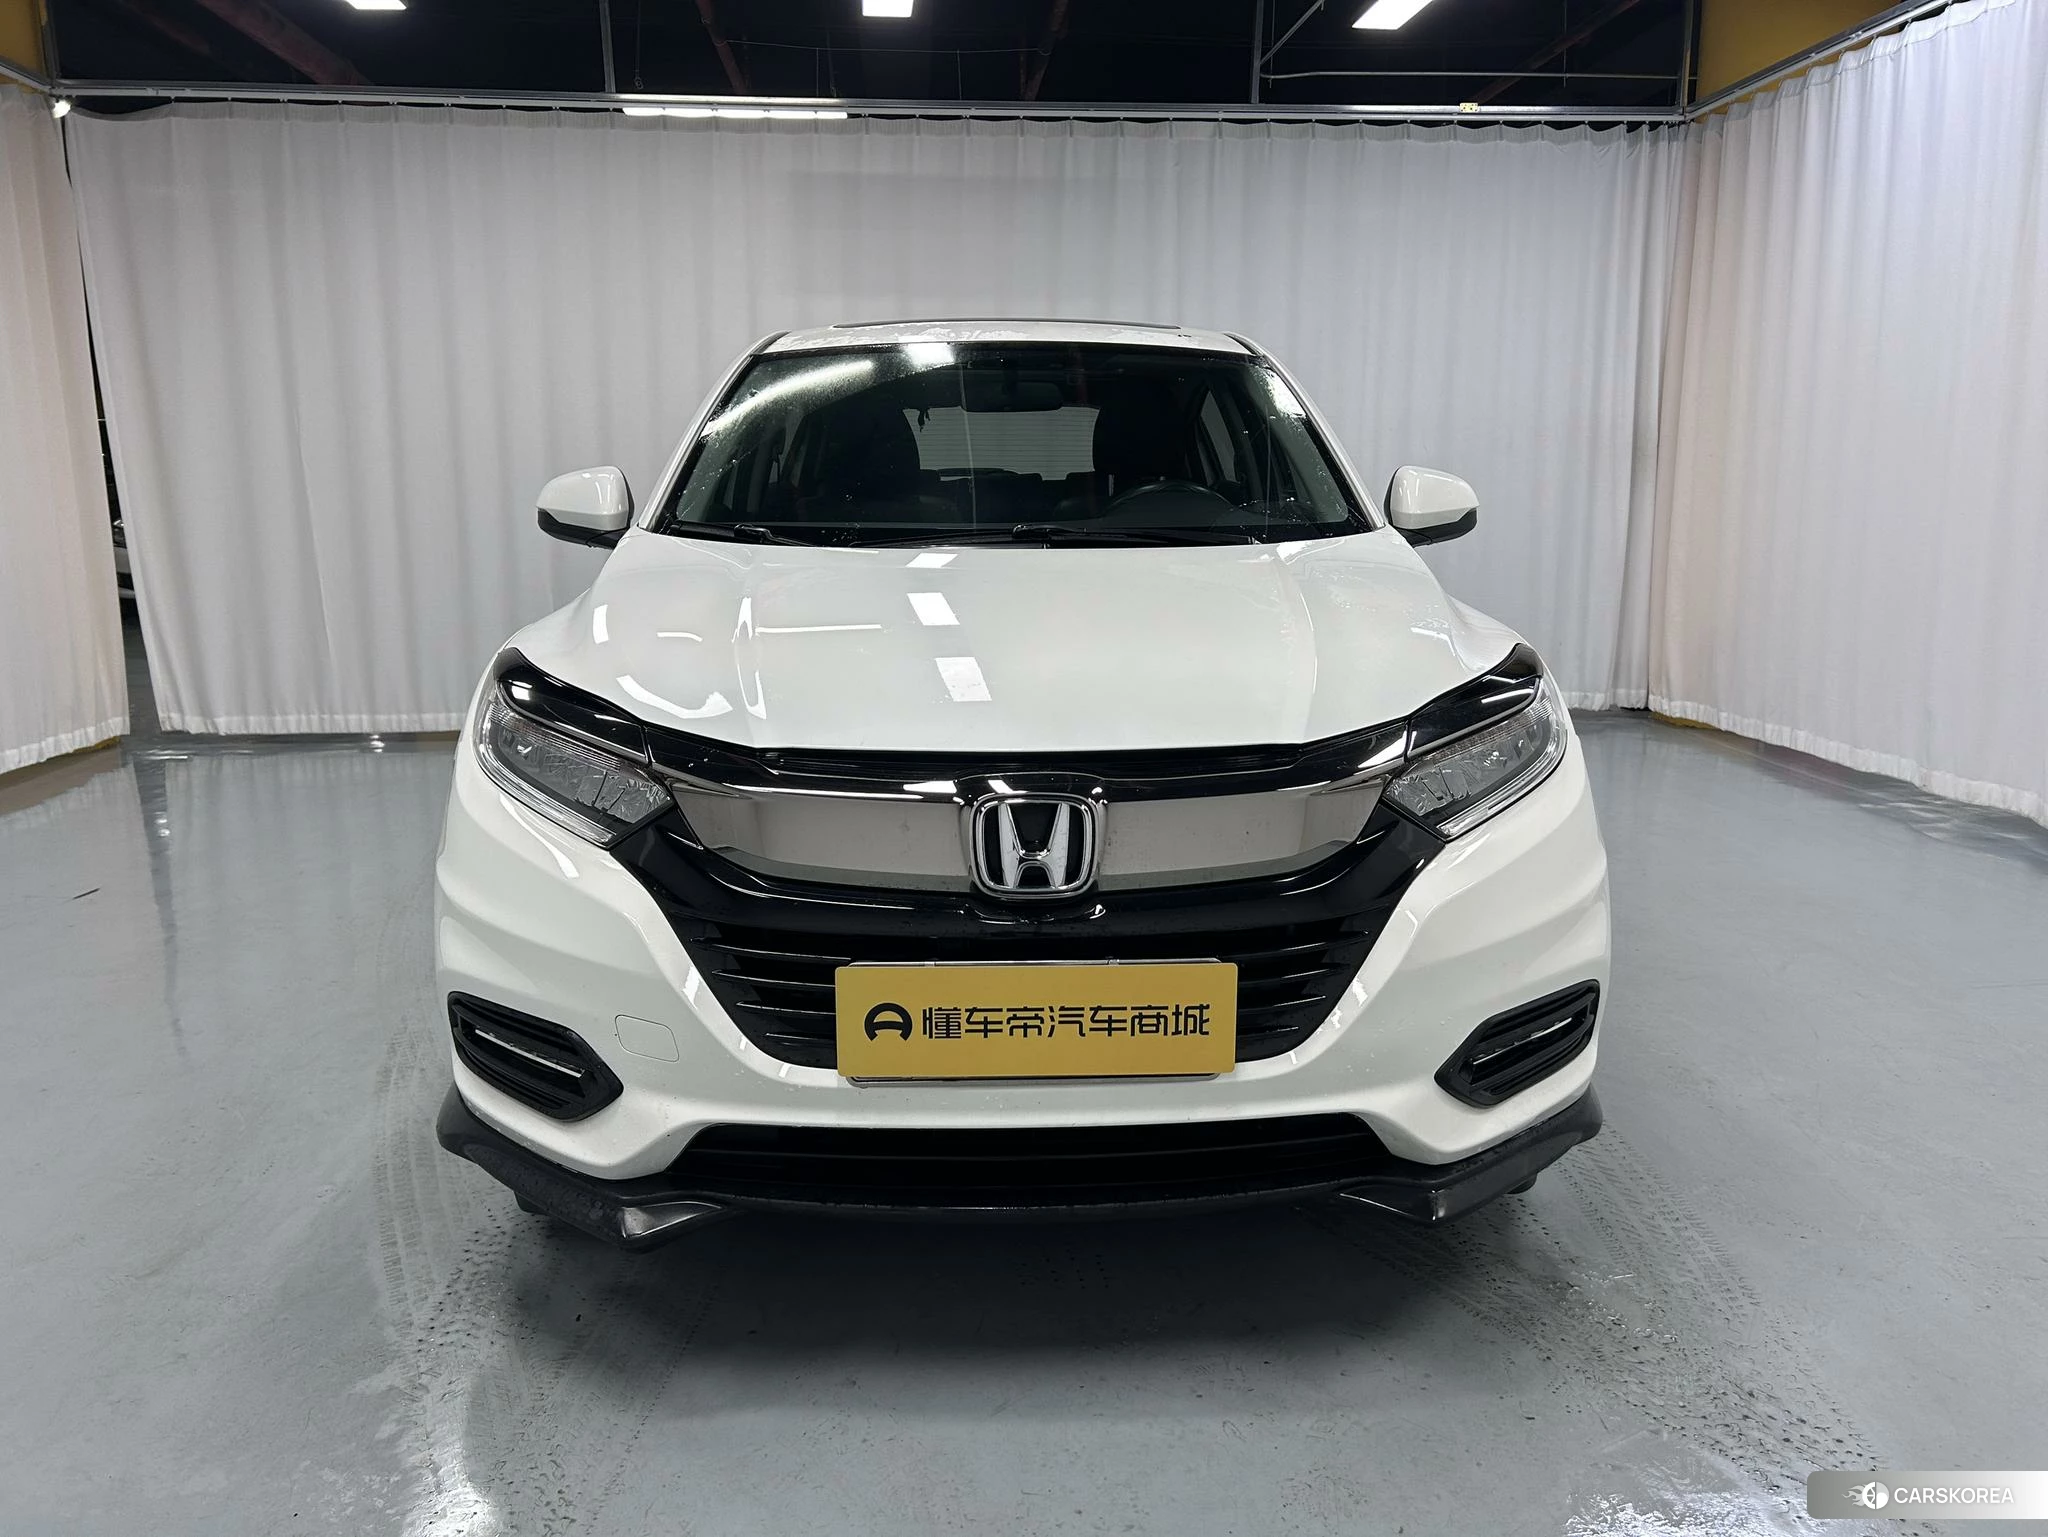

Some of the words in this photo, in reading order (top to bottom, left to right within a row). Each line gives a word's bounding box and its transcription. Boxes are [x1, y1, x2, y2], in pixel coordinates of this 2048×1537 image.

[922, 1003, 1210, 1039] 懂车帝汽车商城
